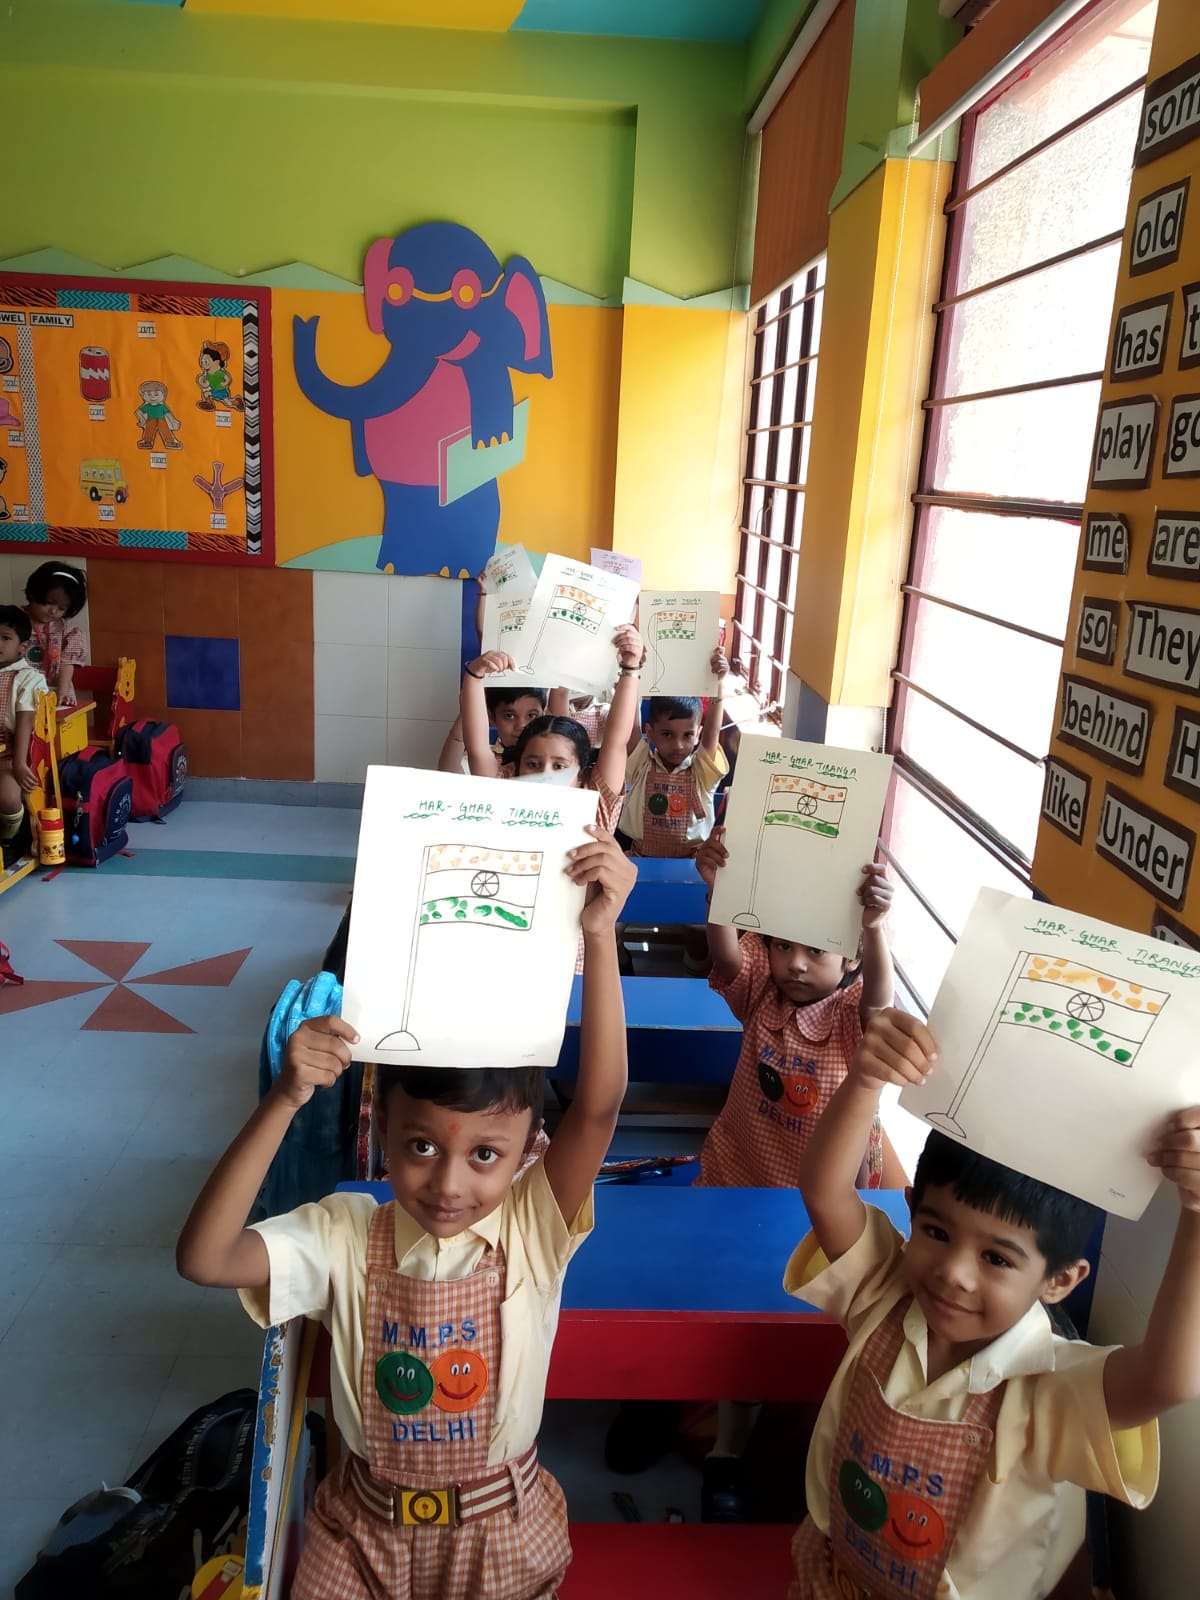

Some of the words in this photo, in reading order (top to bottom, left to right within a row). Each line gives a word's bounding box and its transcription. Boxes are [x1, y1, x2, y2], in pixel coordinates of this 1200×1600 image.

[1136, 192, 1183, 258] old
[0, 313, 24, 323] WEL
[32, 315, 71, 325] FAMILY
[1117, 321, 1162, 369] has
[1097, 412, 1151, 471] play
[1089, 523, 1124, 558] me
[1154, 524, 1200, 565] are
[1082, 611, 1108, 648] so
[1137, 609, 1200, 681] They
[1064, 685, 1146, 759] behind
[790, 755, 814, 767] GHAR
[816, 762, 857, 776] TIRANGA
[459, 802, 494, 814] GHAR
[510, 808, 560, 820] TIRANGA
[1046, 769, 1081, 830] like
[1103, 799, 1184, 890] Under
[1079, 930, 1118, 949] GHAR
[1136, 948, 1200, 976] TIRANGA
[392, 1417, 475, 1442] DELHI
[845, 1523, 918, 1593] DELHI
